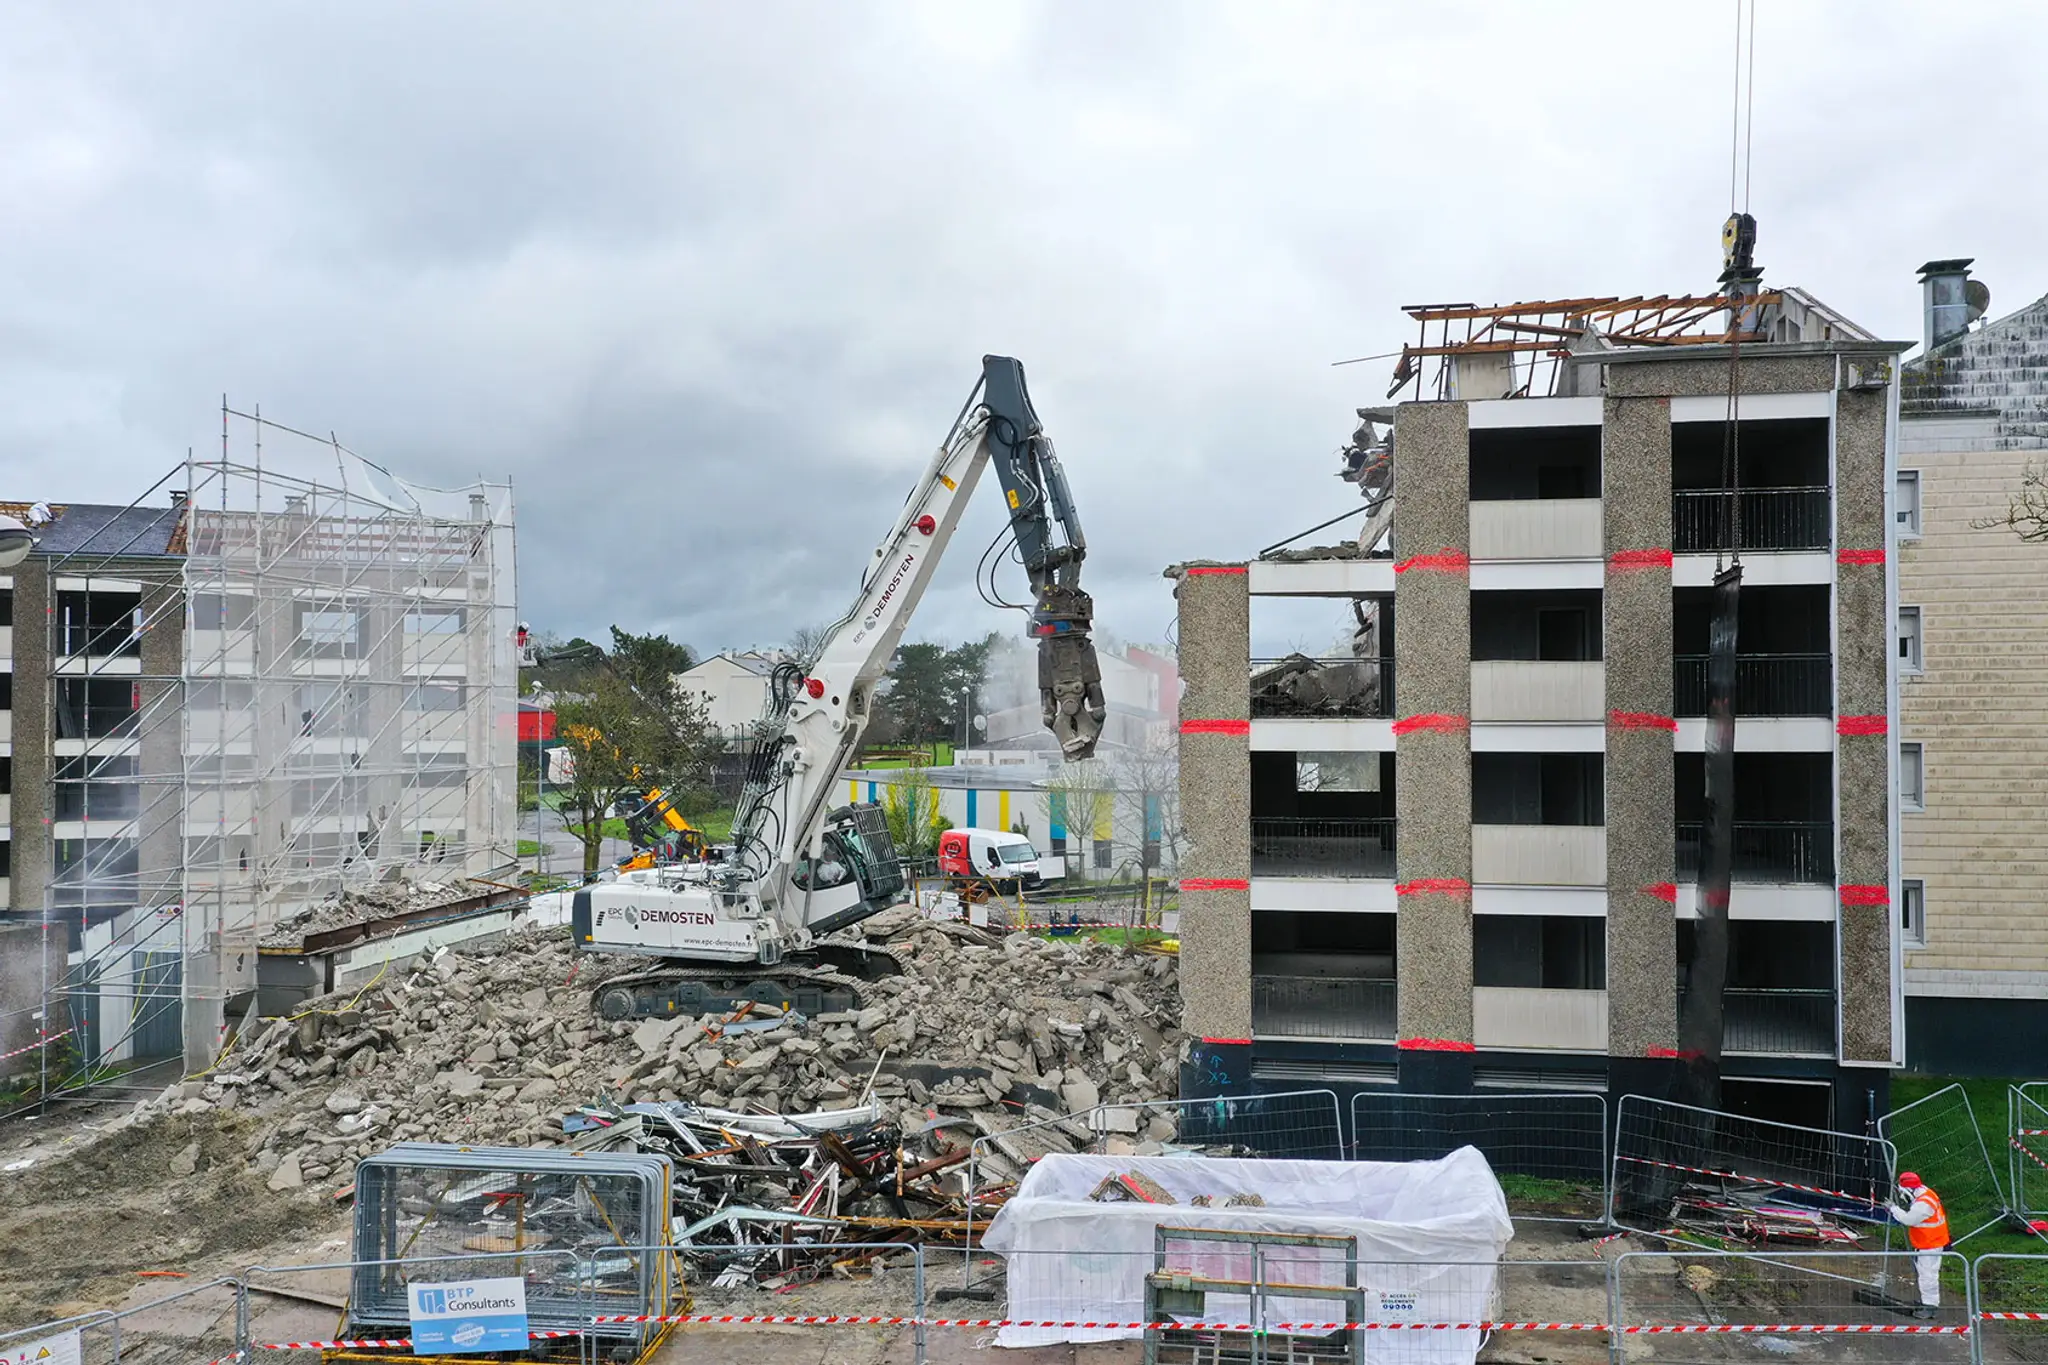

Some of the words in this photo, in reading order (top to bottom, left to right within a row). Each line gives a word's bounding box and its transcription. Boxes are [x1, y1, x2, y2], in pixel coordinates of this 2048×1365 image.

[872, 554, 914, 618] DEMOSTEN
[607, 908, 623, 916] EPC
[640, 910, 714, 925] DEMOSTEN
[684, 937, 753, 948] www.epc-demosten.fr
[447, 1287, 474, 1299] BTP
[448, 1298, 516, 1311] Consultants
